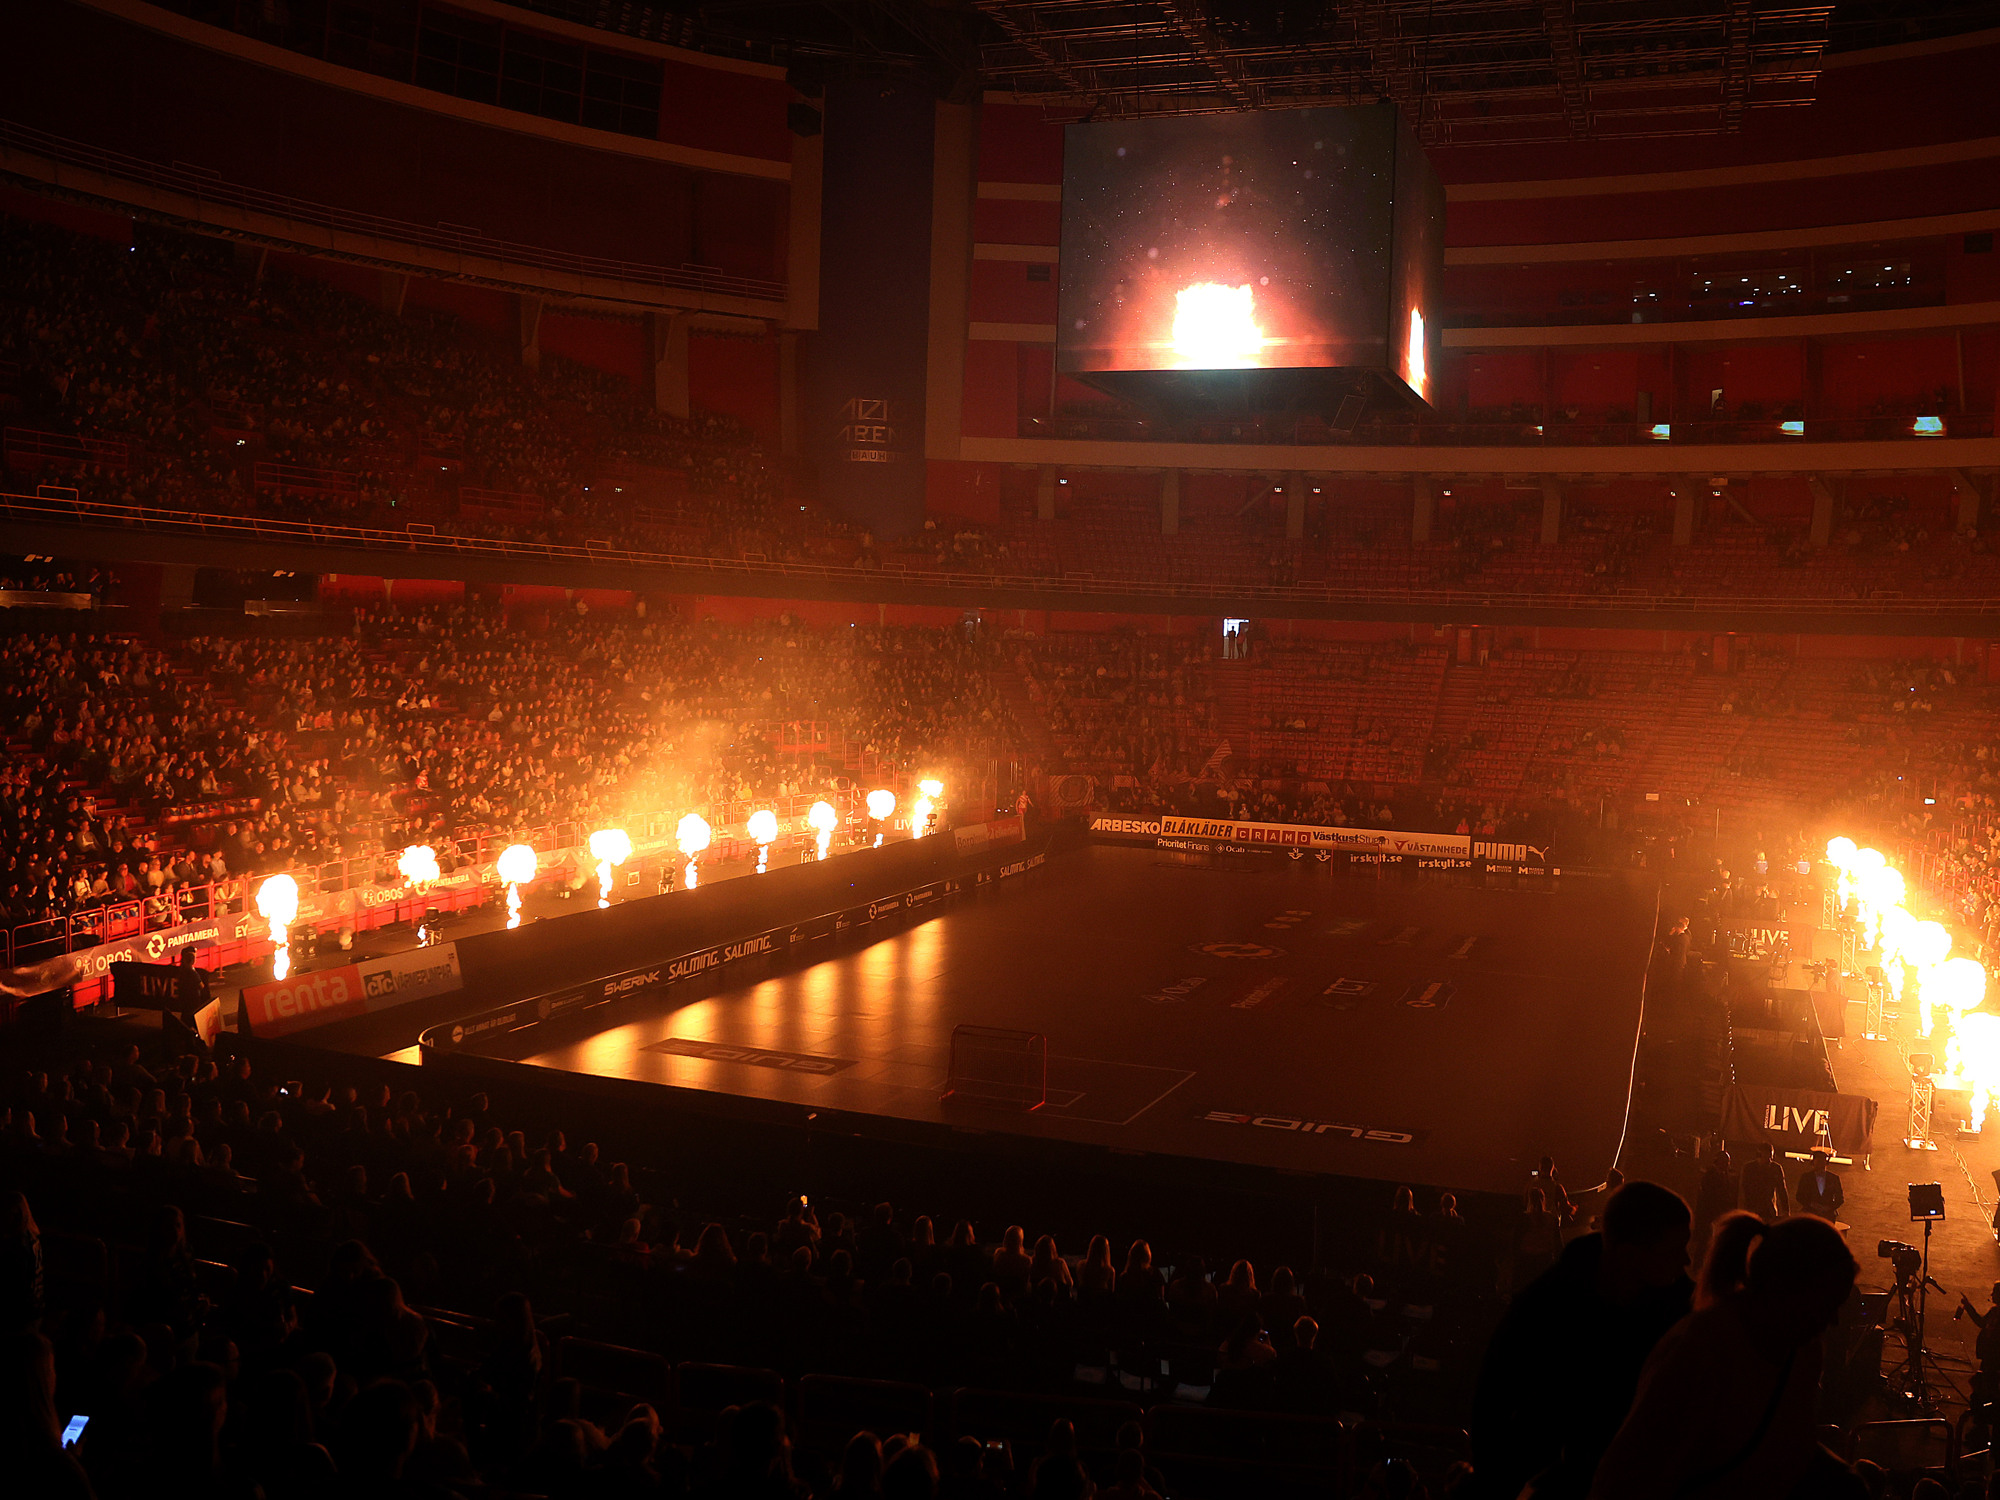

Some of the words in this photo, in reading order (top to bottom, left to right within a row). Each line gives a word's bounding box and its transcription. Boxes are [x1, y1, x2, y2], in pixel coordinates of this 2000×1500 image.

[1090, 818, 1161, 835] ARBESKO
[1163, 819, 1233, 838] BLÅKLÄDER
[1157, 838, 1187, 849] Prioritet
[1187, 841, 1210, 852] Finans
[1239, 830, 1307, 843] CRAMO
[1225, 845, 1245, 853] Ocab
[1407, 843, 1468, 855] VÄSTANHEDE
[1473, 841, 1527, 862] PUMA
[1350, 854, 1403, 865] irskylt.se
[1418, 859, 1472, 870] irskylt.se
[377, 887, 404, 903] OBOS
[167, 928, 220, 948] PANTAMERA
[235, 924, 248, 939] EY
[143, 975, 179, 999] LIVE
[604, 970, 660, 996] SWERINK
[263, 975, 349, 1022] renta
[1204, 1111, 1413, 1144] GUIDE
[1768, 1104, 1829, 1136] LIVE
